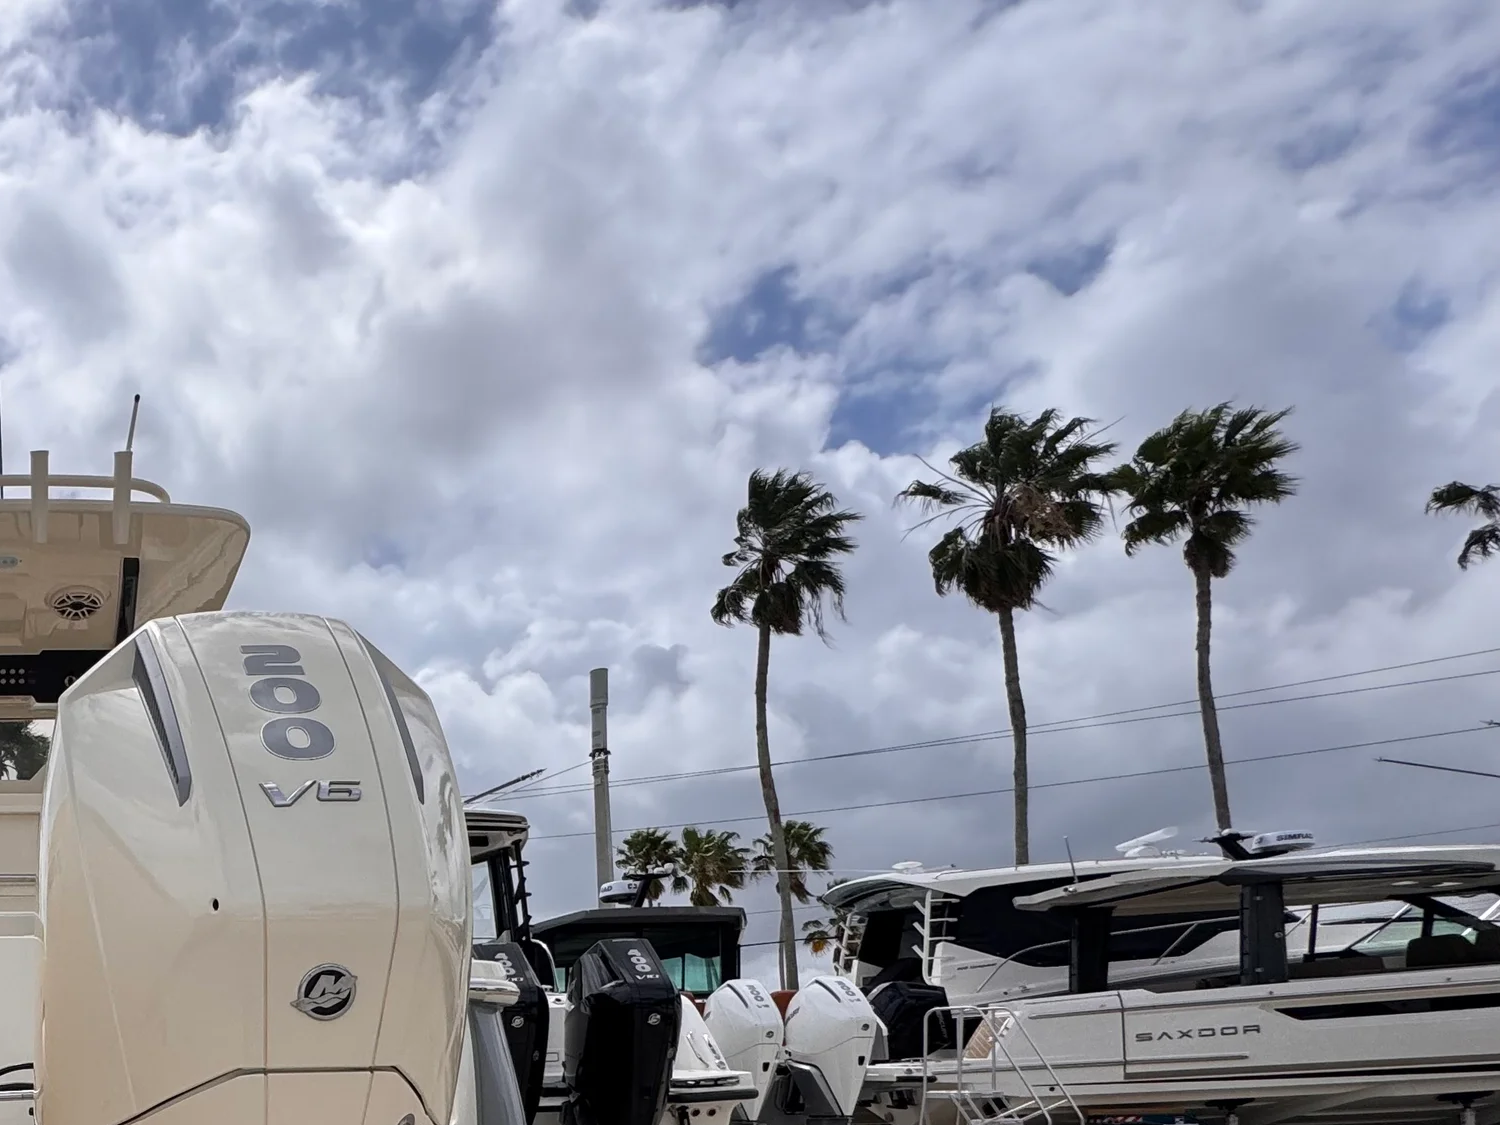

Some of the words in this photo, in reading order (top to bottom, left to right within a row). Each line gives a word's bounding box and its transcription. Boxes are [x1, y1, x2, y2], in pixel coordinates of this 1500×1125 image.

[239, 644, 337, 762] 200
[258, 779, 362, 807] V6
[1135, 1024, 1260, 1042] SAXDOR
